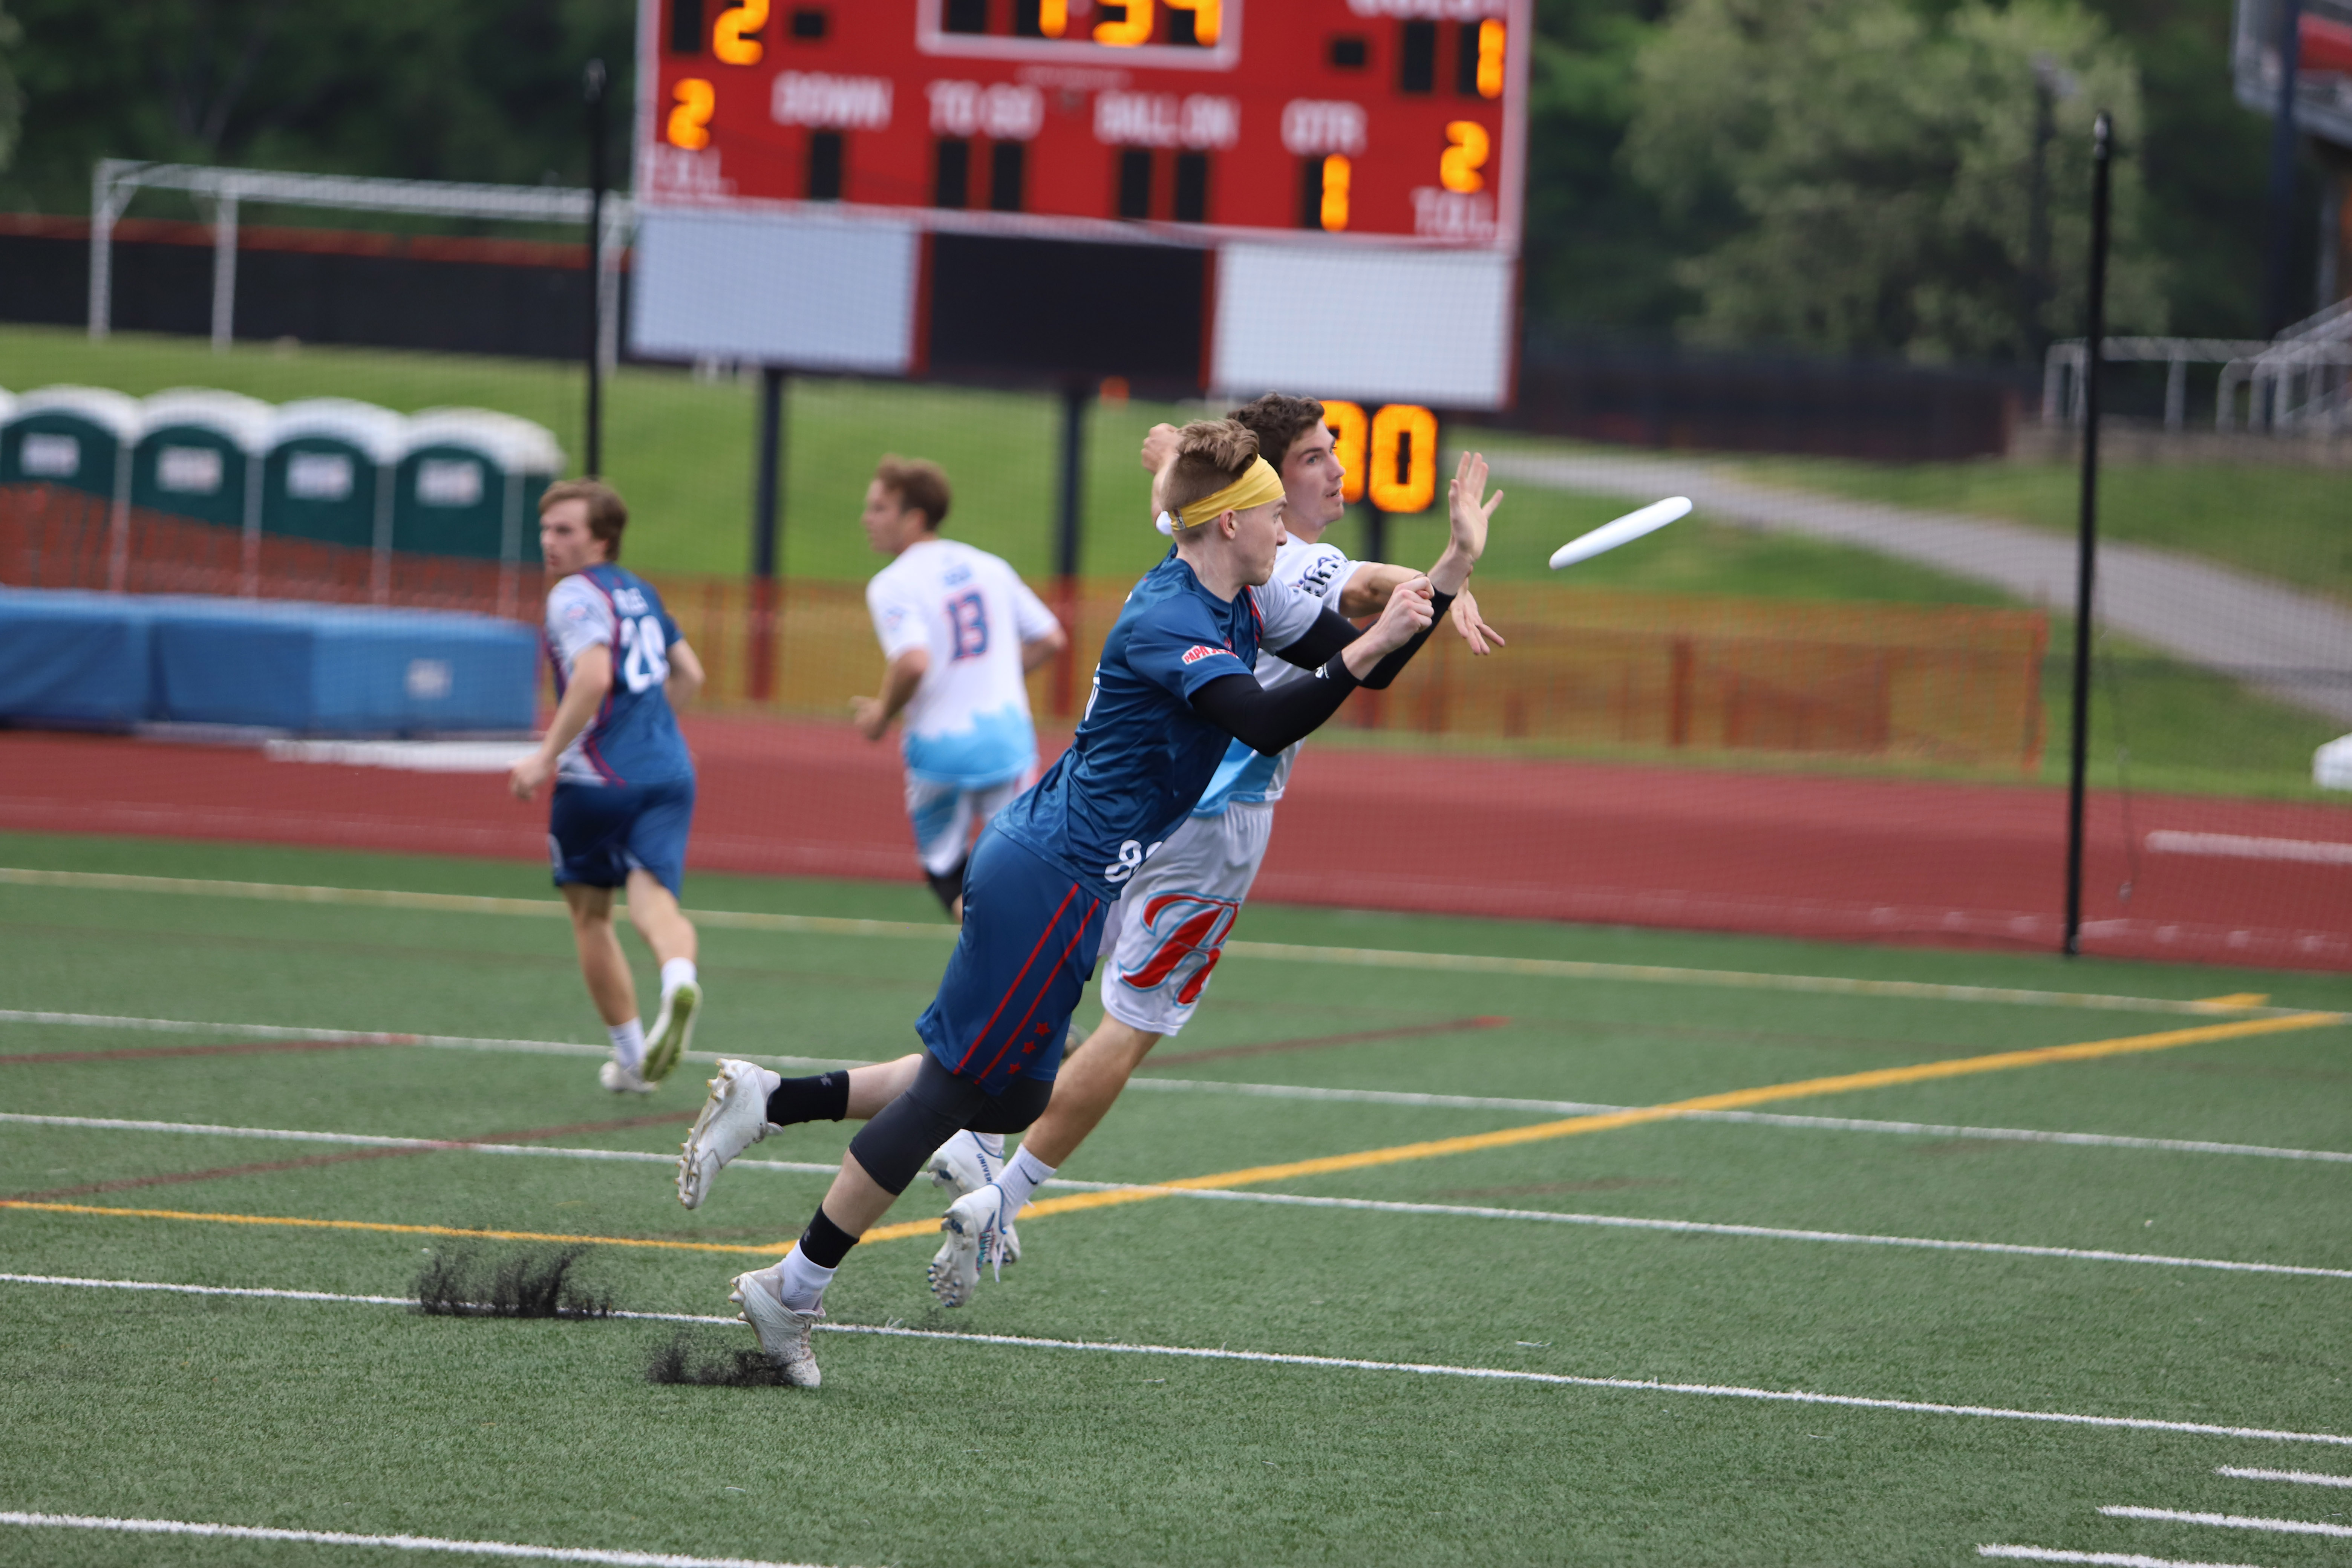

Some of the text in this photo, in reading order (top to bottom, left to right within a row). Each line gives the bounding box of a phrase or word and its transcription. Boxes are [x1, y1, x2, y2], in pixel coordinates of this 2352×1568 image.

[713, 0, 769, 66] 2
[1476, 18, 1505, 99] 1
[667, 78, 715, 150] 2
[771, 72, 893, 130] DOWN
[1282, 99, 1367, 156] QTR
[1440, 121, 1490, 194] 2
[1320, 154, 1351, 233] 1
[1184, 646, 1211, 663] PAPA
[976, 1153, 992, 1183] UNIVER
